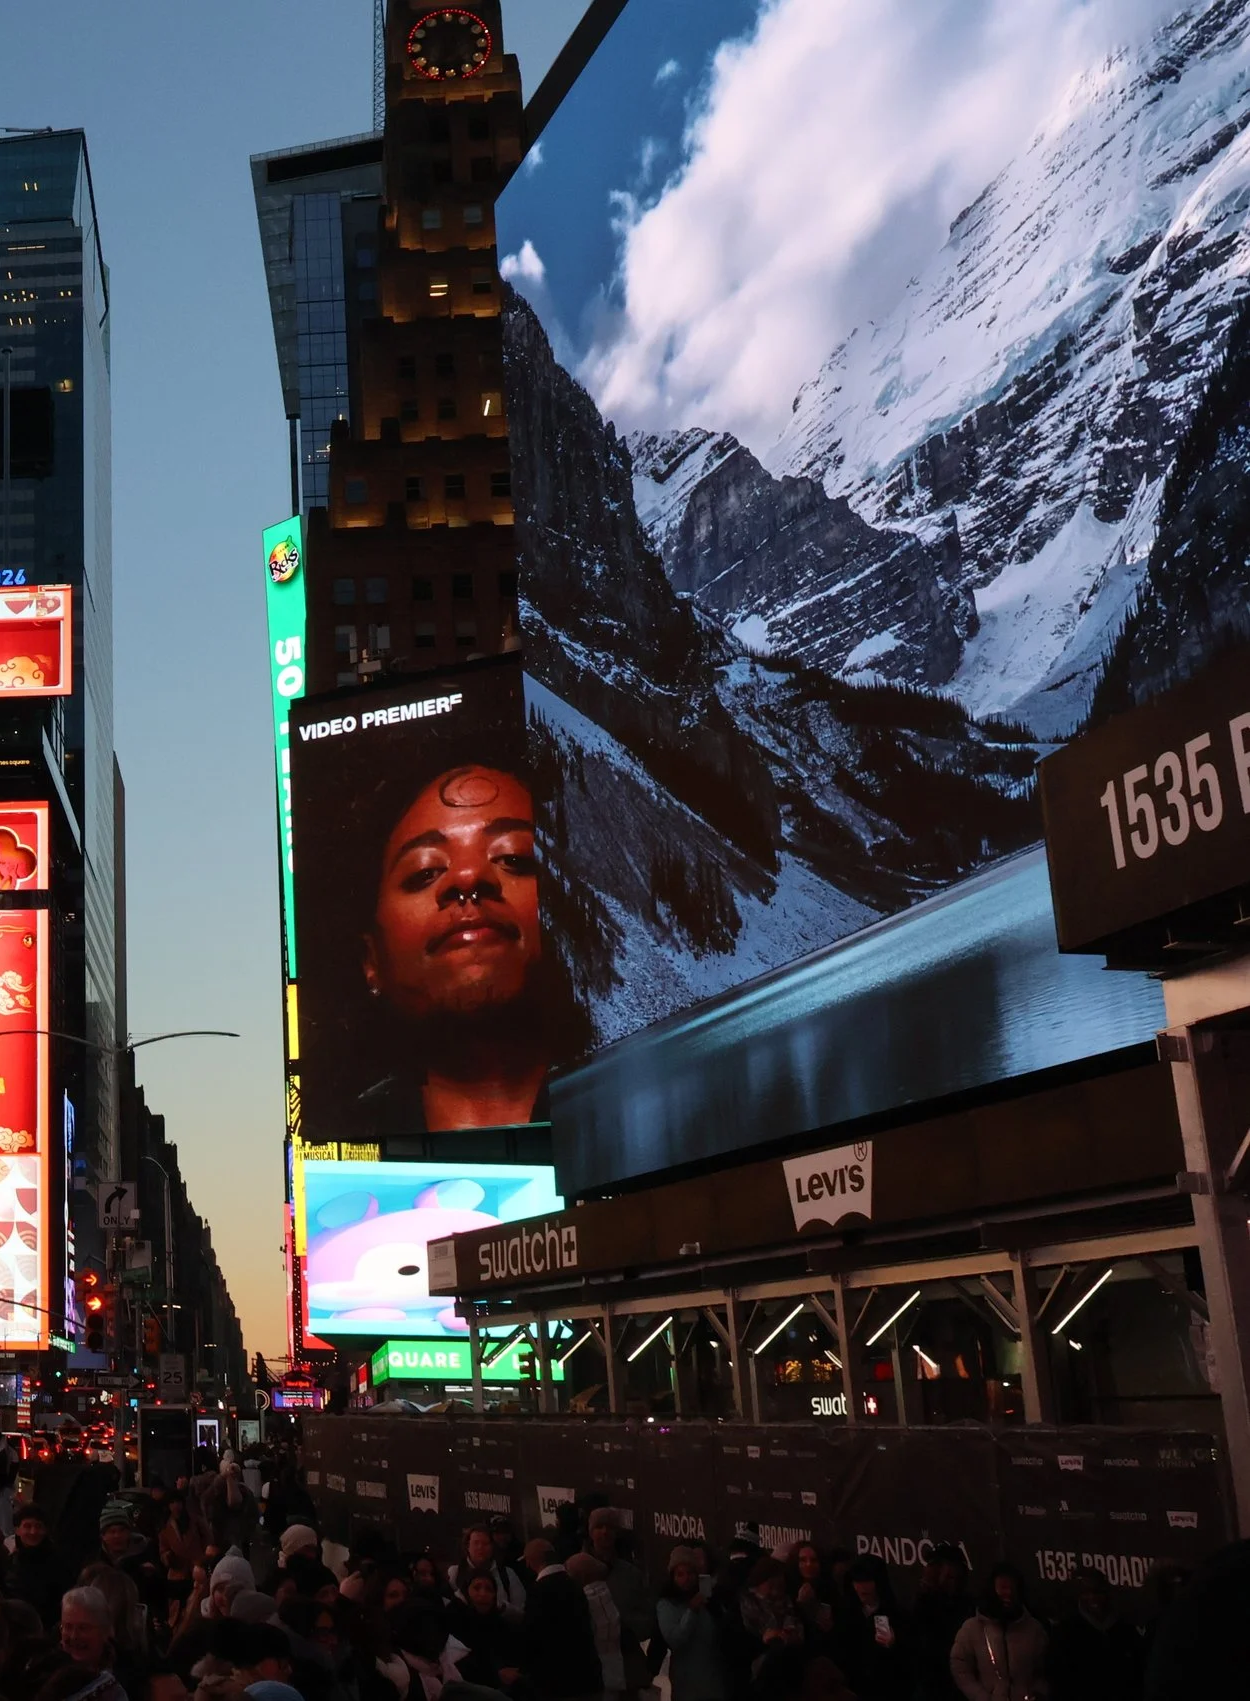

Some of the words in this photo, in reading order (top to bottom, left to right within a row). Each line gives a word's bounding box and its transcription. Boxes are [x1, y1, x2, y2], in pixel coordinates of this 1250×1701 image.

[299, 716, 357, 741] VIDEO
[1100, 731, 1224, 870] 1535
[303, 1150, 335, 1161] MUSICAL
[478, 1221, 560, 1282] swatch
[163, 1371, 183, 1385] 25
[654, 1511, 706, 1540] PANDORA
